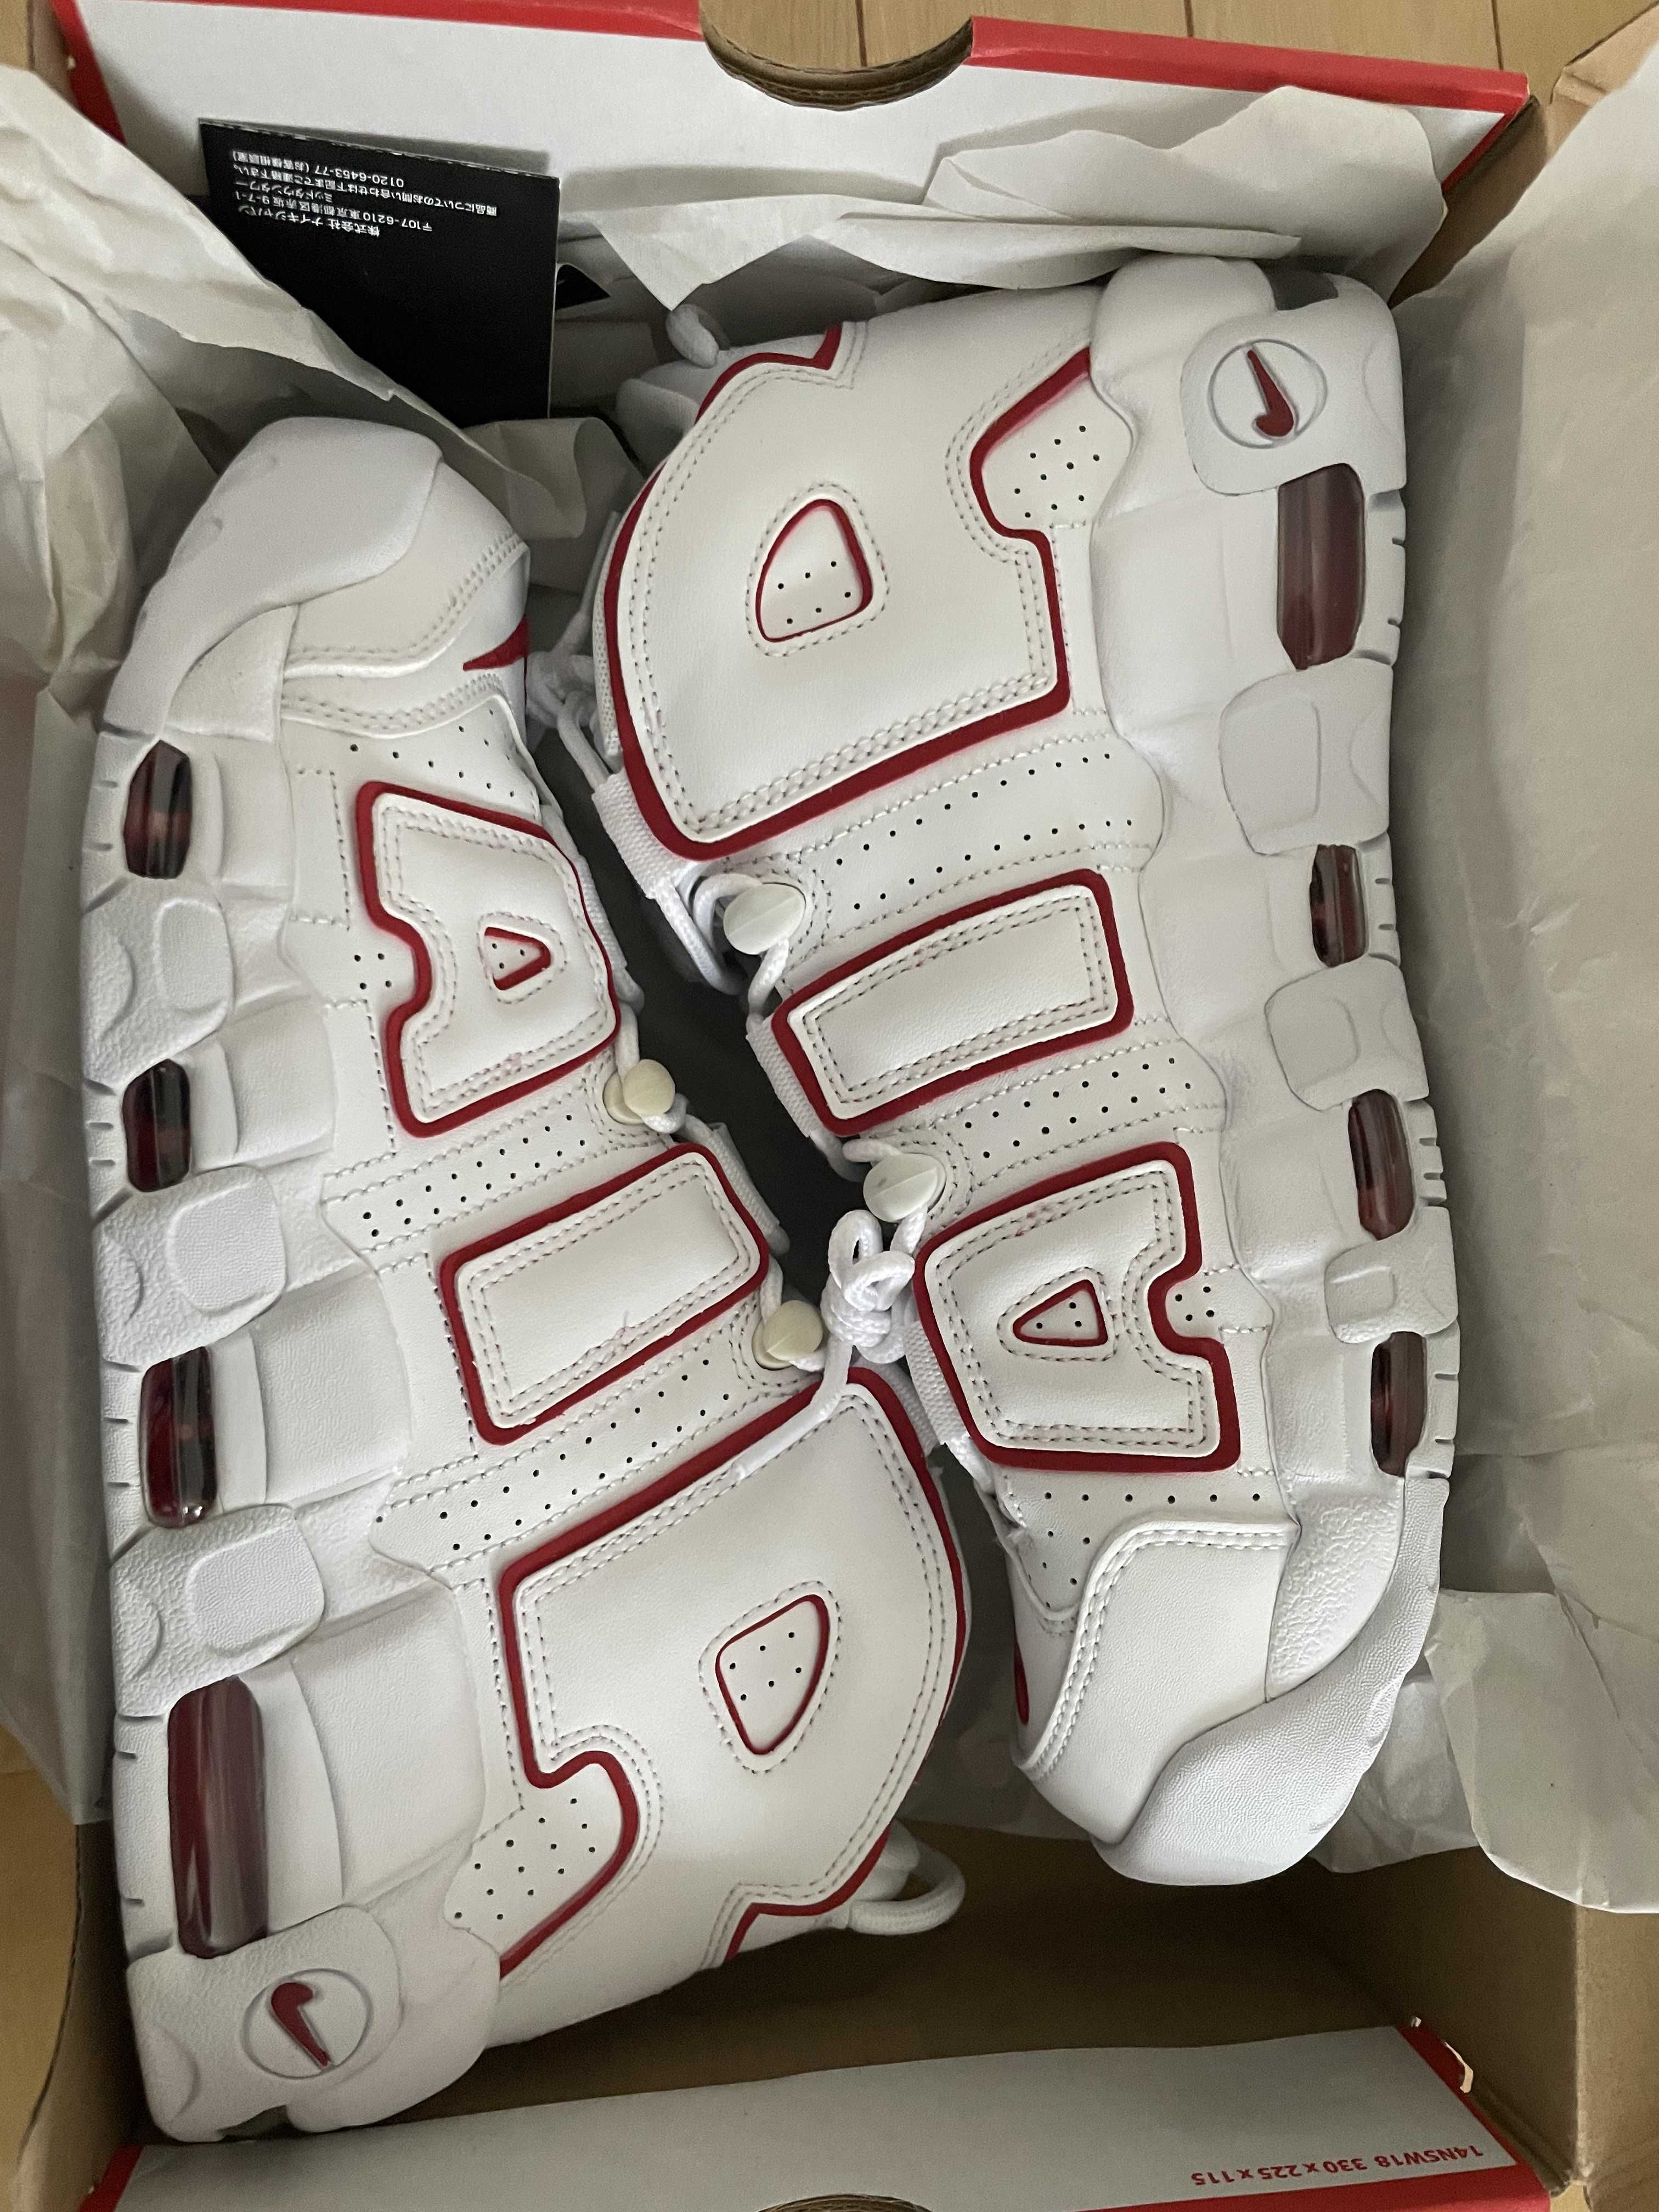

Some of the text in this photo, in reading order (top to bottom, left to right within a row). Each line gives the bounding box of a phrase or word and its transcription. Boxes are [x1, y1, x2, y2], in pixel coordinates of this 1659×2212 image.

[314, 165, 405, 188] 0120-6453-77
[235, 180, 332, 203] ミッドタウンタワー
[236, 190, 270, 206] 9-7-1
[272, 196, 362, 220] 東京都港区赤坂
[238, 204, 380, 237] 株式会社 ナイキジャパン
[1323, 2157, 1368, 2175] 330
[1374, 2144, 1483, 2168] 14NSW18
[1191, 2170, 1235, 2186] 115
[1259, 2165, 1302, 2180] 225
